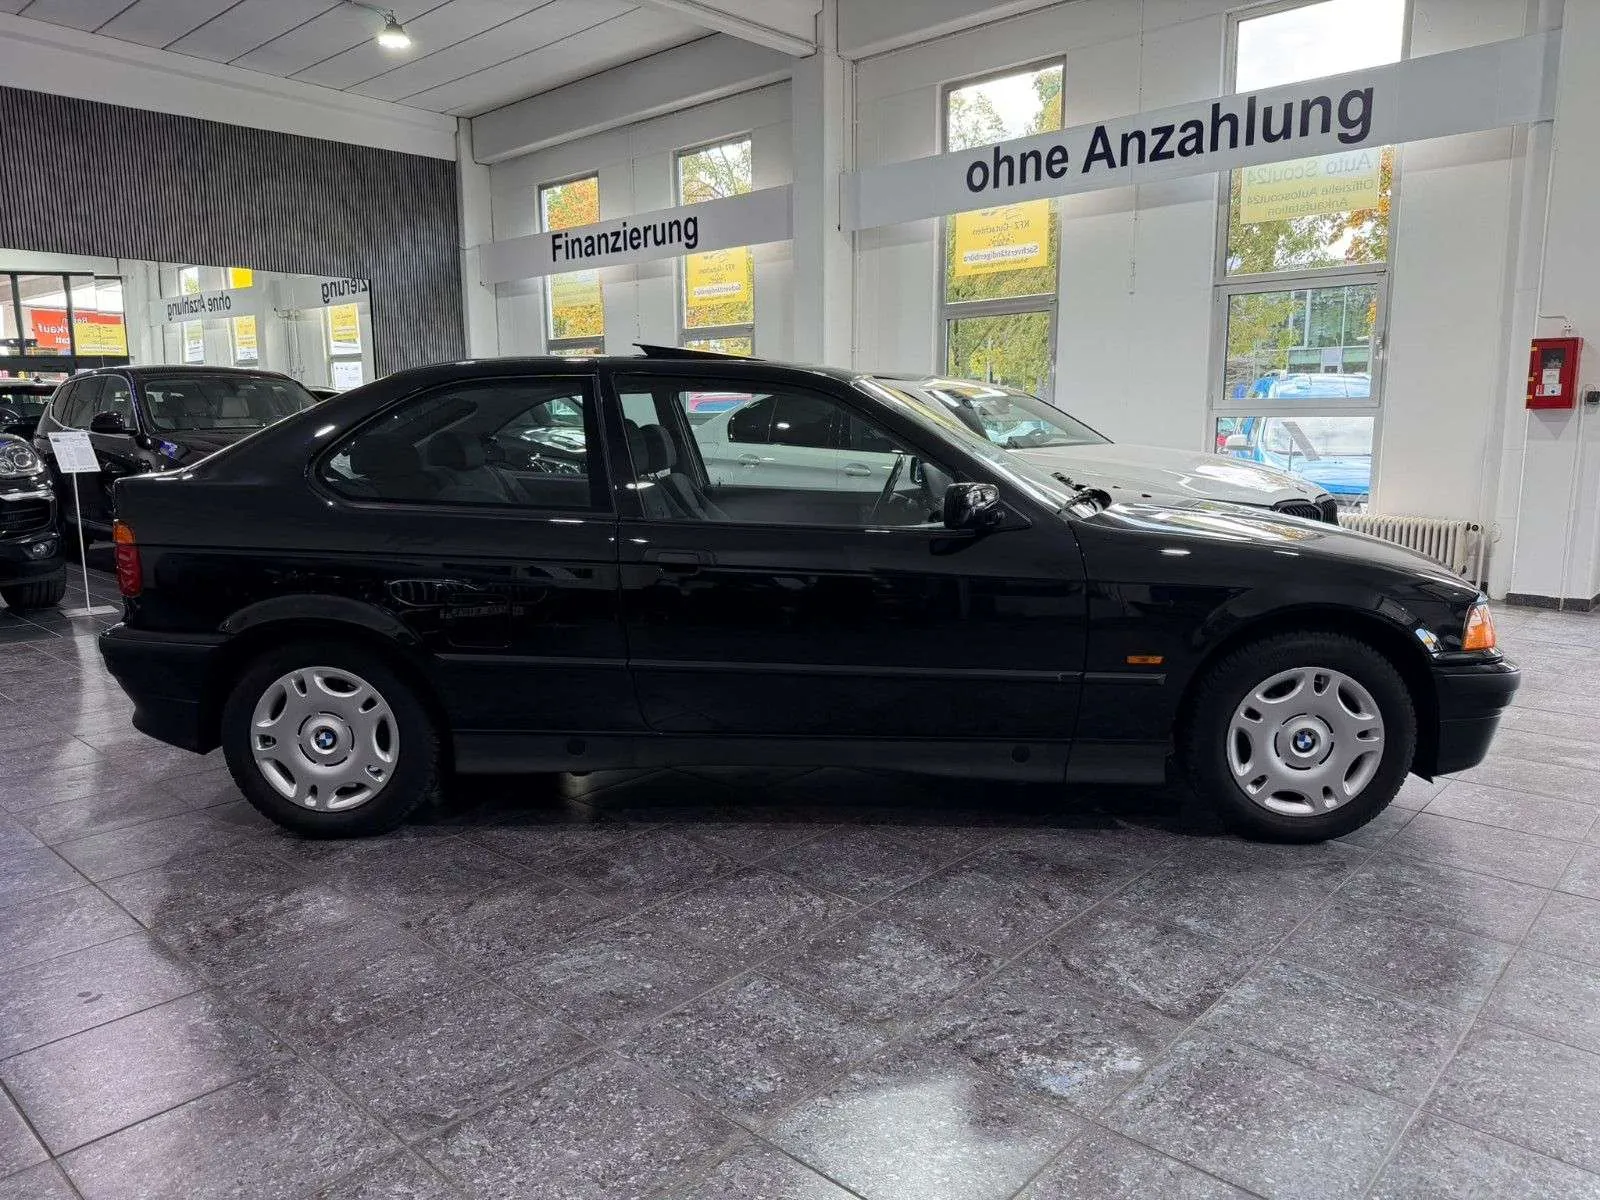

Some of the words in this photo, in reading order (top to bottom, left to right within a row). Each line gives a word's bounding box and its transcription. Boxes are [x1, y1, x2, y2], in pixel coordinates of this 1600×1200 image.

[966, 145, 1069, 193] ohne
[1081, 86, 1374, 174] Anzahlung
[551, 216, 698, 262] Finanzierung
